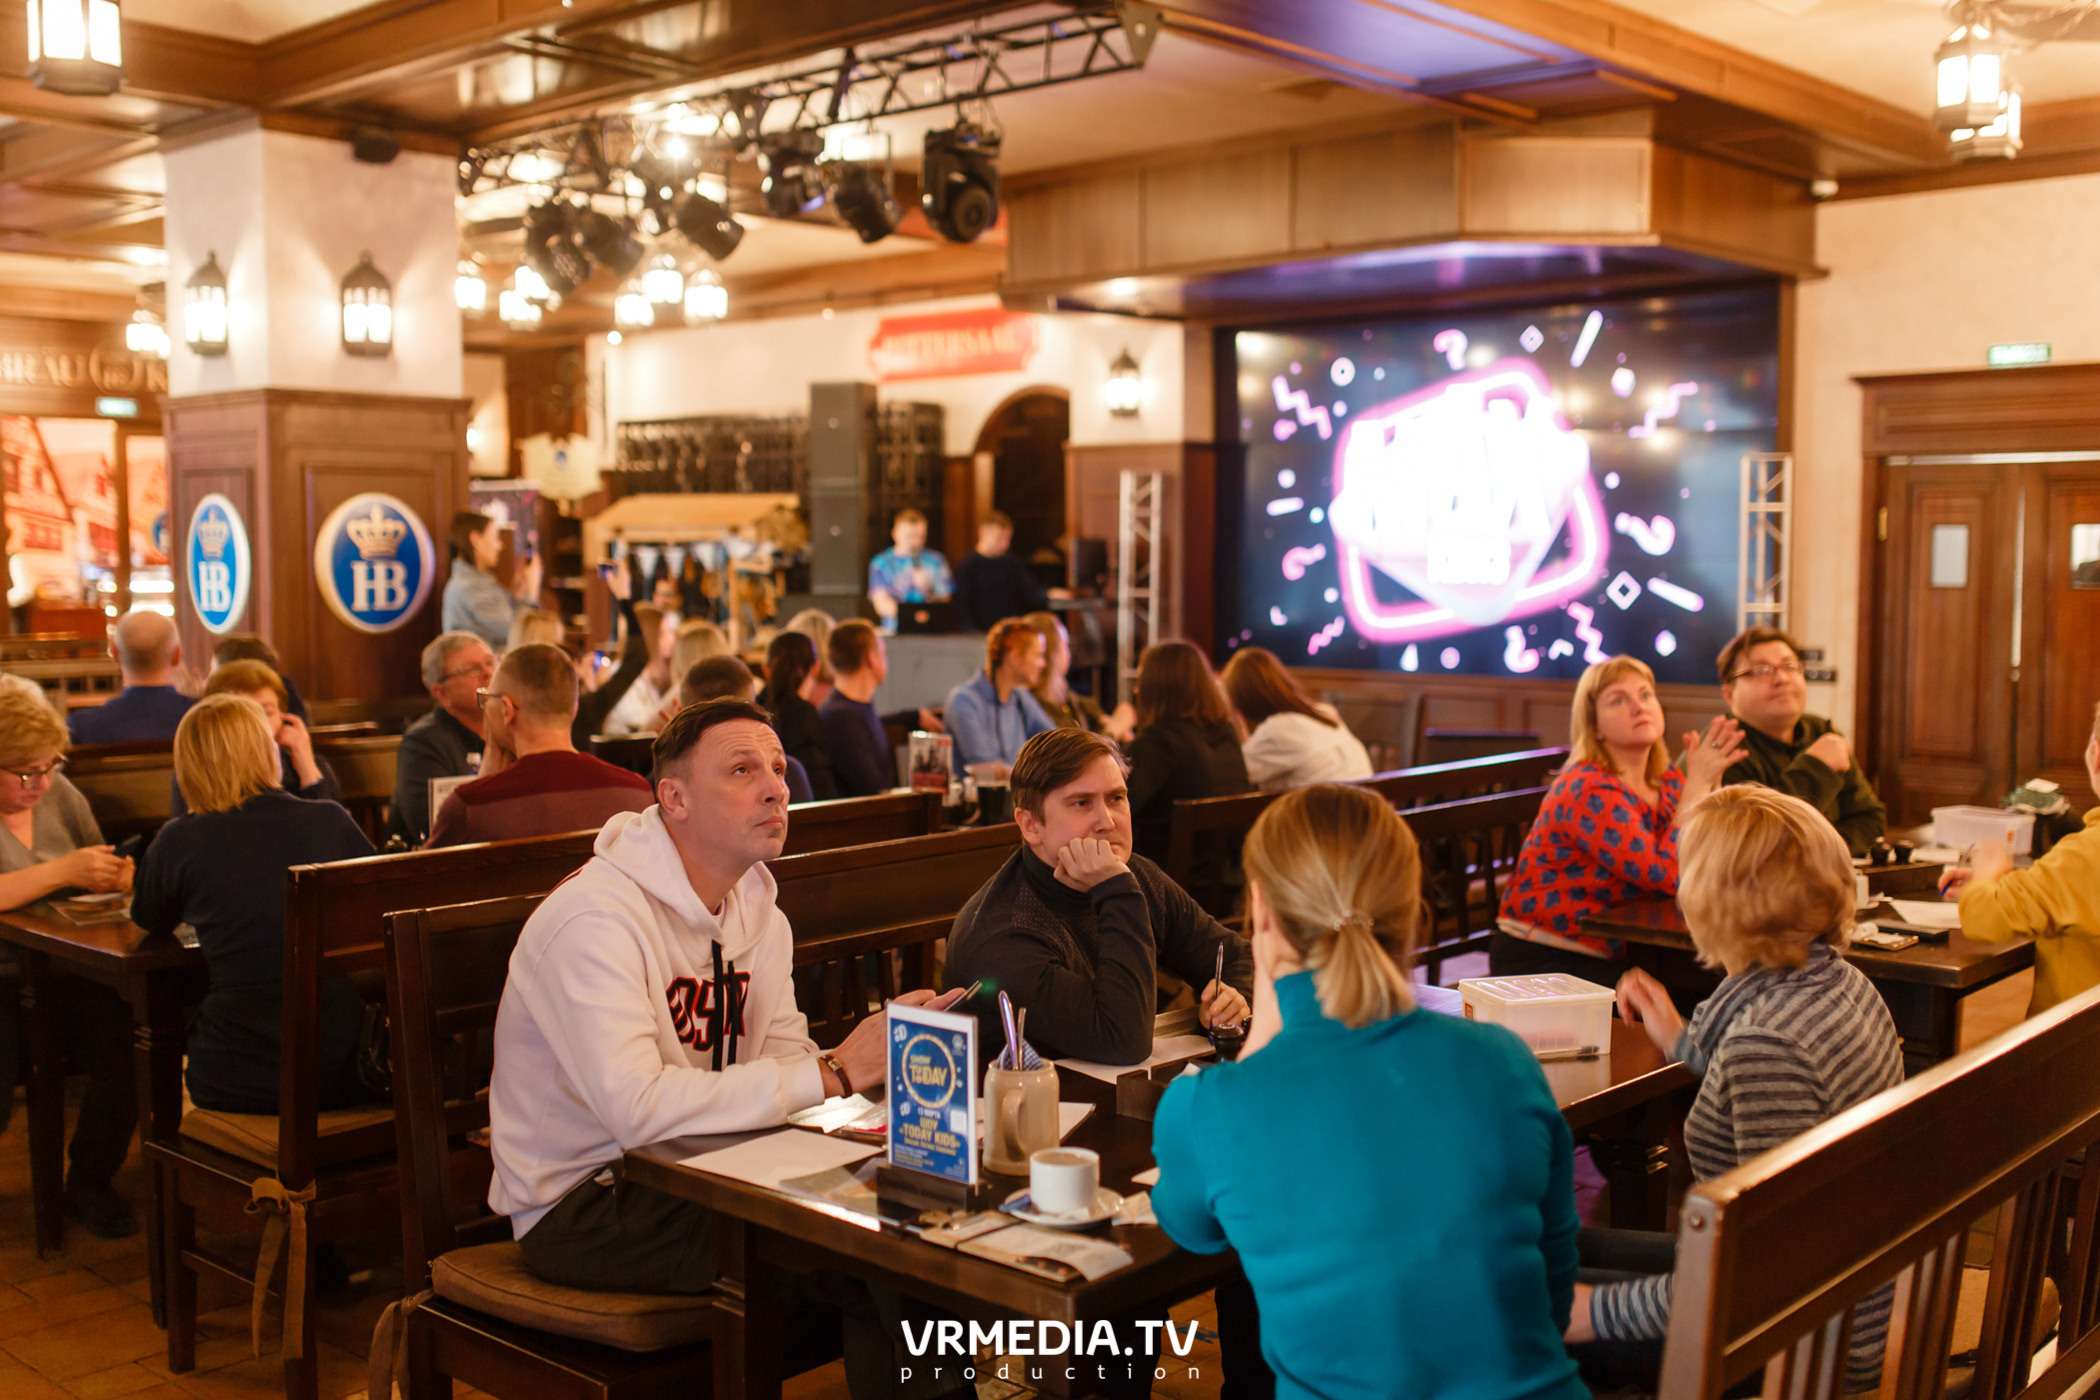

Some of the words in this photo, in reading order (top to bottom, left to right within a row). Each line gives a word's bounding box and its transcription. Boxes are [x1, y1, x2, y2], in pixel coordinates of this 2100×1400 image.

[198, 560, 231, 612] HB
[352, 560, 408, 612] HB
[909, 1064, 947, 1086] TODAY
